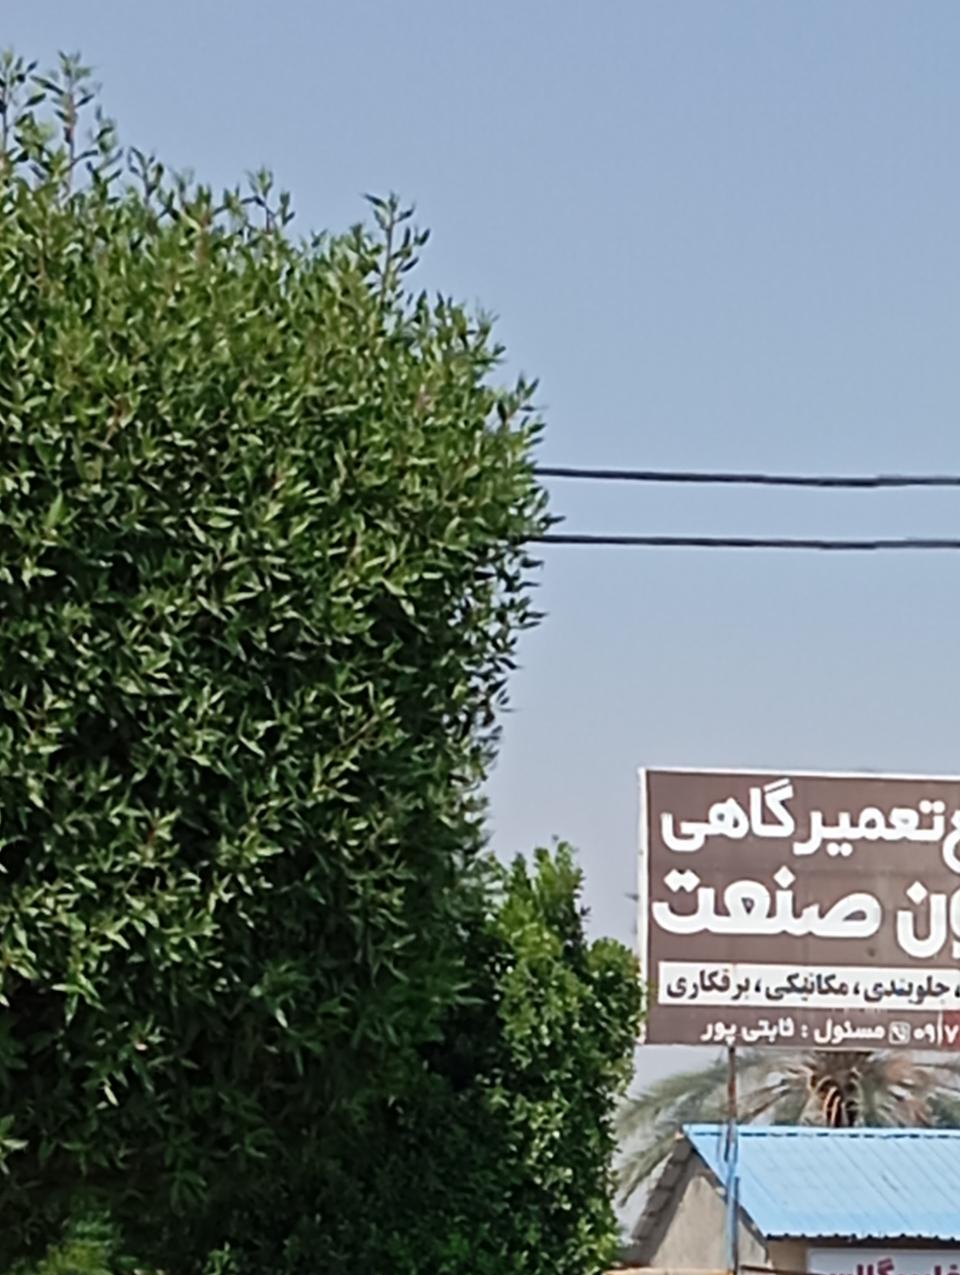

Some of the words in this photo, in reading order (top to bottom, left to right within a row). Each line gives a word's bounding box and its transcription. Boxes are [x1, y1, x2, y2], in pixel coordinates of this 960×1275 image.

[651, 865, 883, 939] صنعت
[666, 968, 751, 1000] برقکاری
[700, 1019, 737, 1046] پور
[813, 1017, 886, 1045] مسئول
